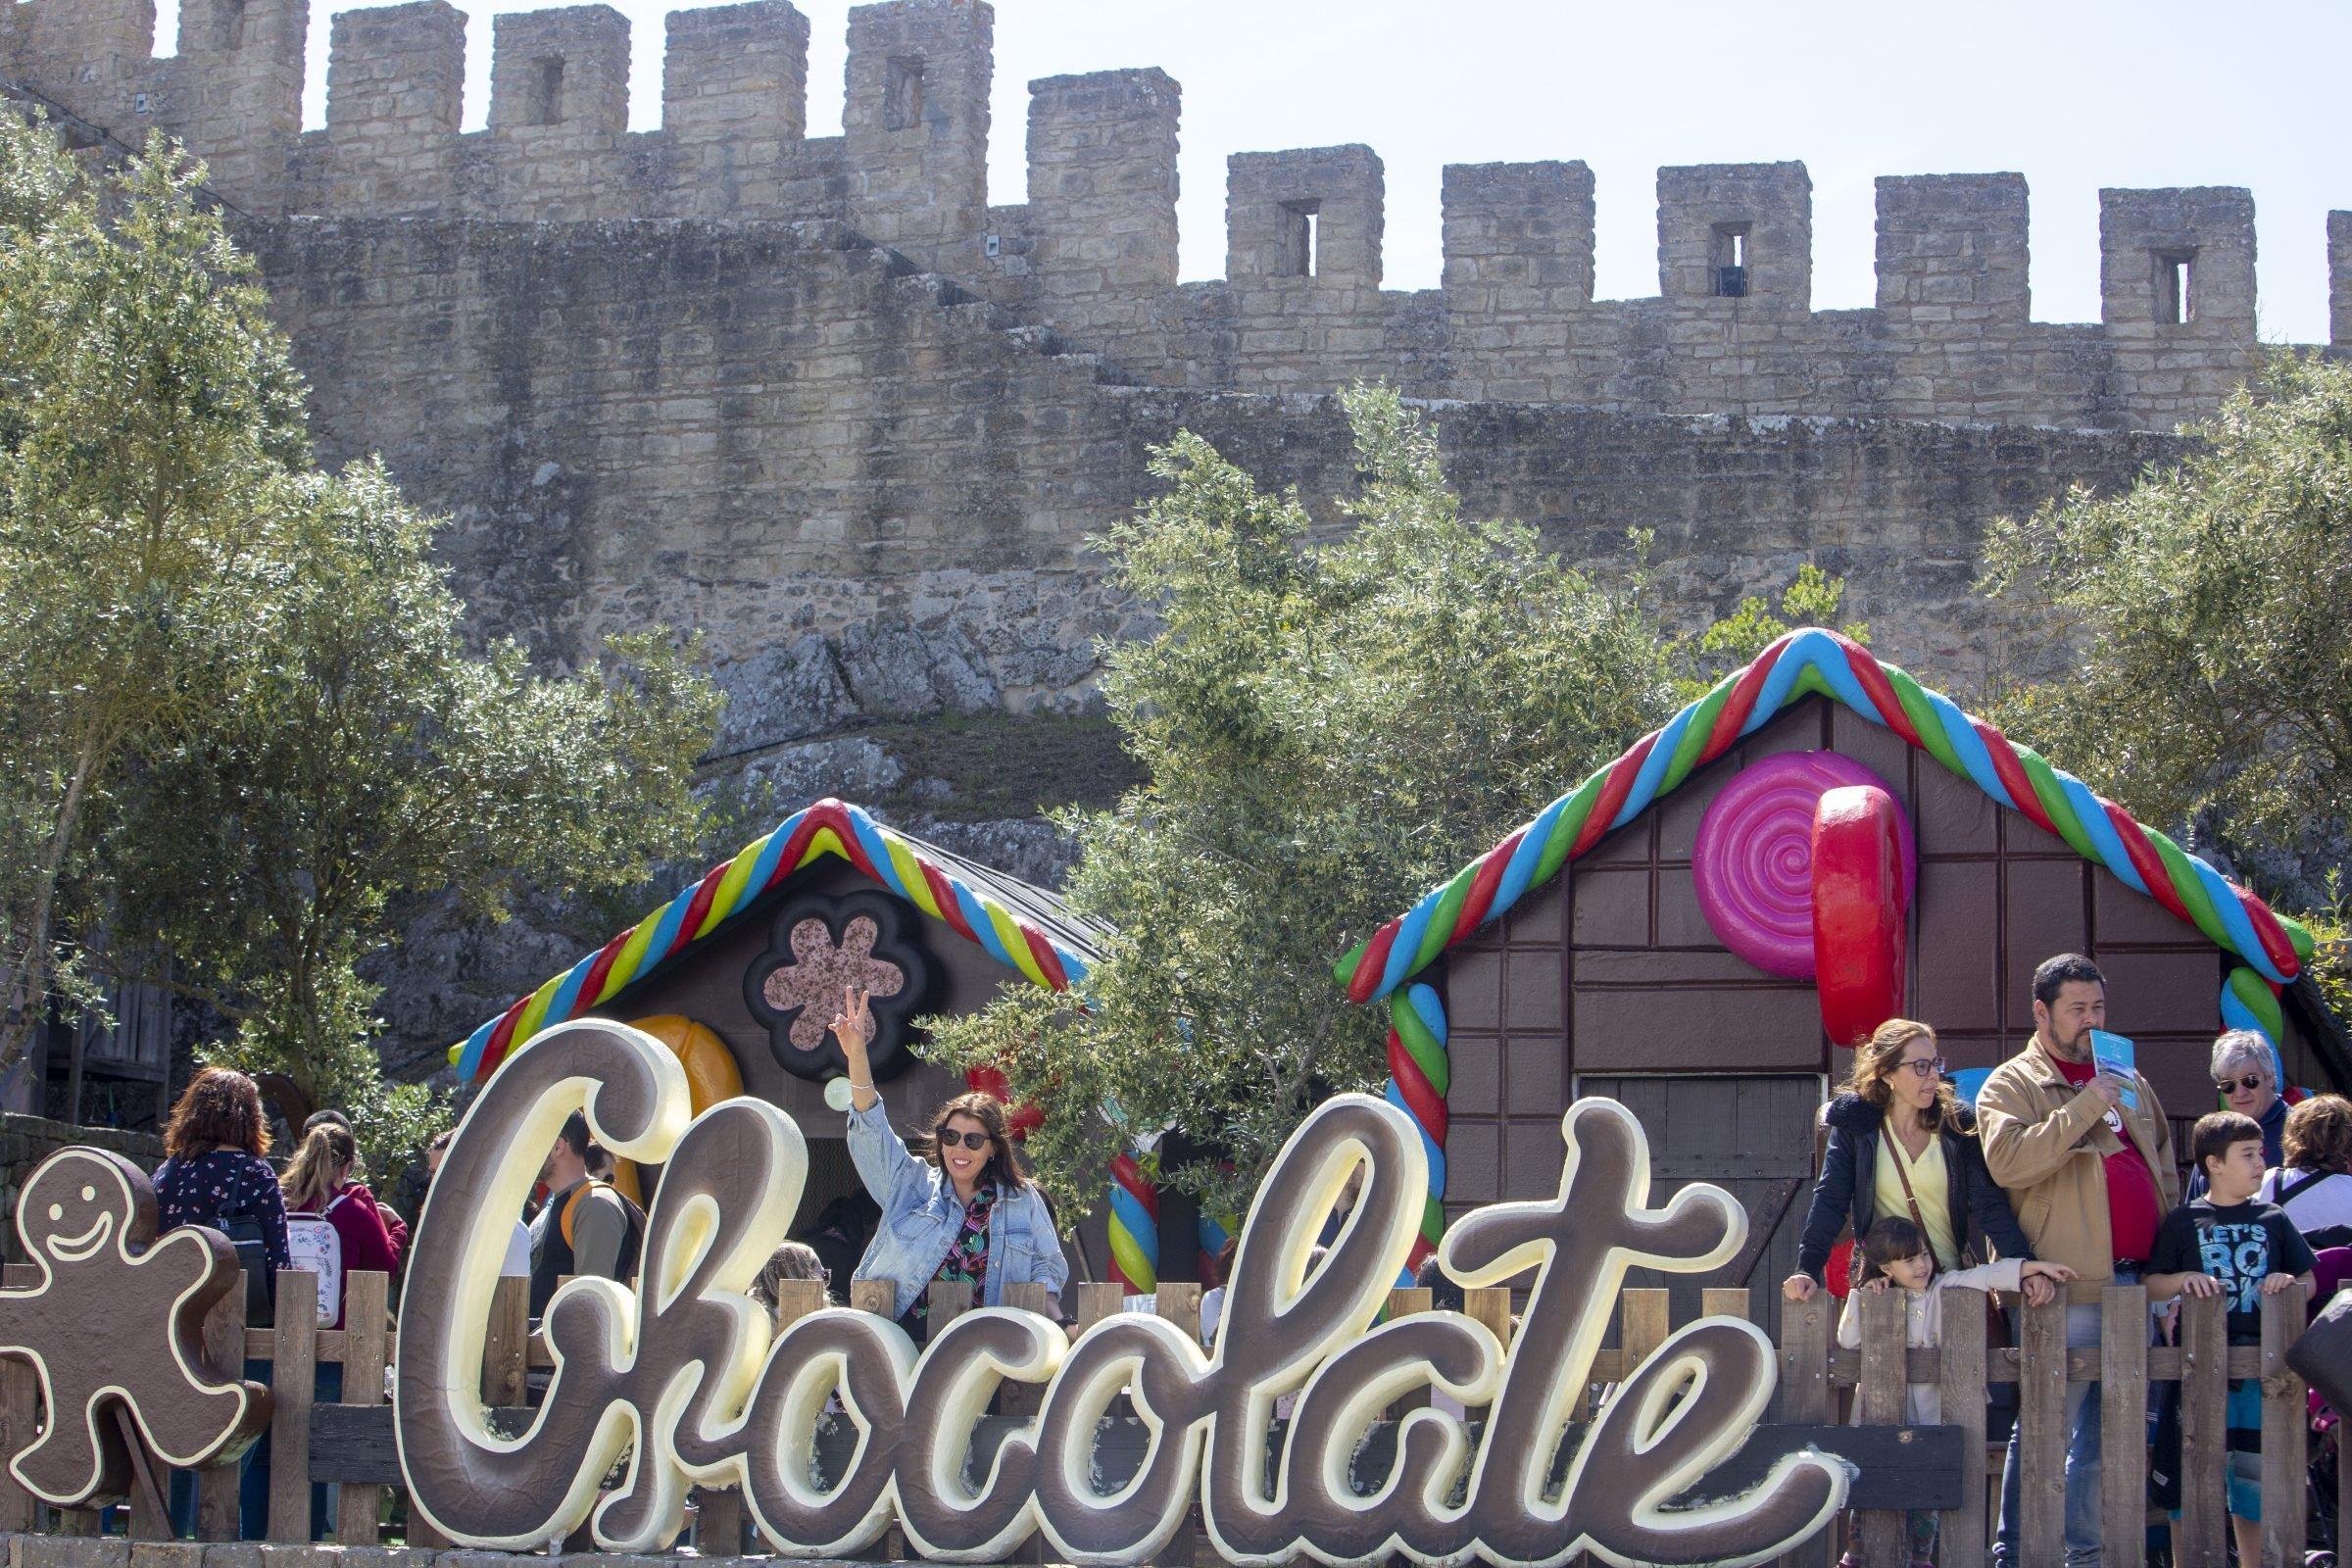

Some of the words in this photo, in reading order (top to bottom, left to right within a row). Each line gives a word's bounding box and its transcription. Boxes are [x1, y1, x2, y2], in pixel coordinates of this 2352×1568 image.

[2197, 1223, 2267, 1246] LET'S
[2199, 1241, 2269, 1278] RO
[394, 1017, 1851, 1566] Chocolate
